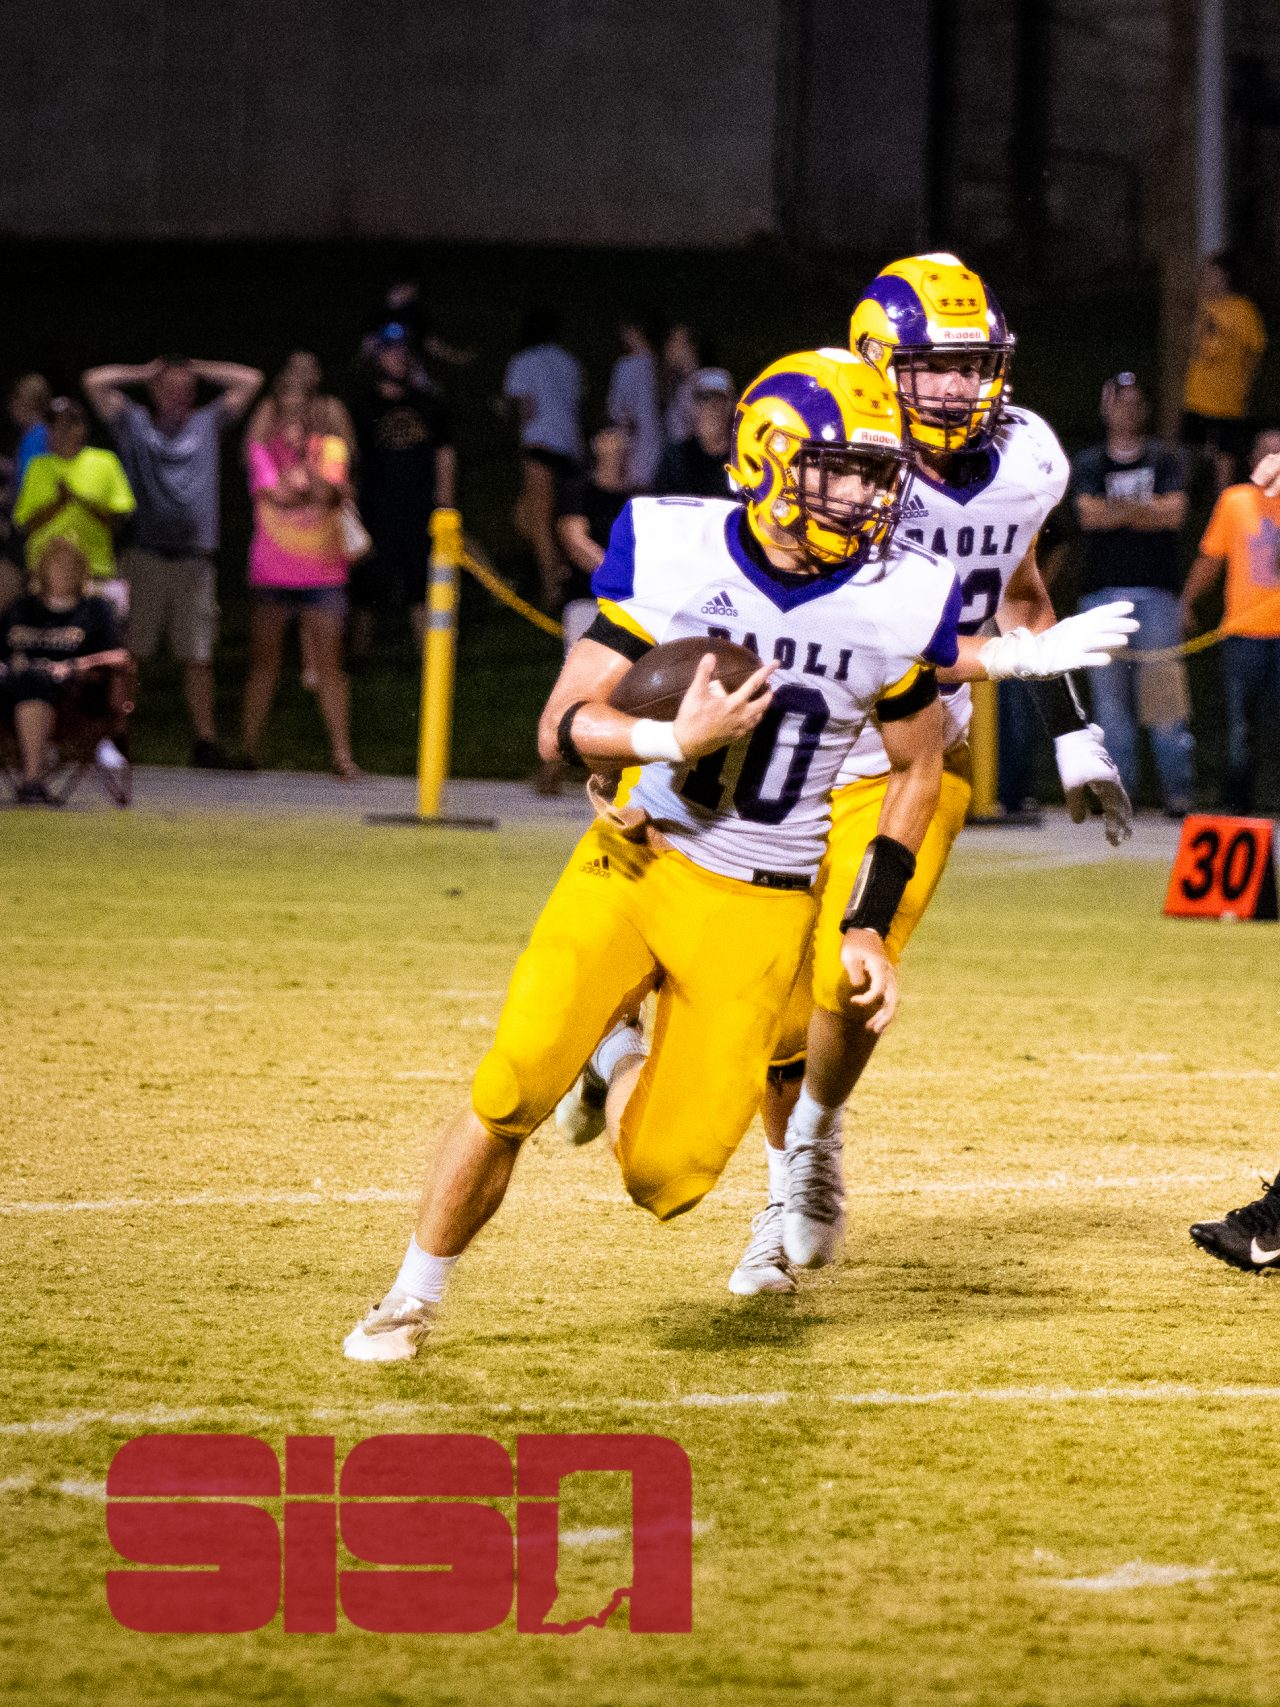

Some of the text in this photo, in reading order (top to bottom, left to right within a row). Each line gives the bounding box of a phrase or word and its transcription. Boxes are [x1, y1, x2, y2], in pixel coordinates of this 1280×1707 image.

[943, 330, 982, 340] Riddell
[861, 431, 896, 446] Riddell
[701, 605, 738, 618] adidas
[579, 863, 612, 879] adidas
[1181, 830, 1257, 901] 30
